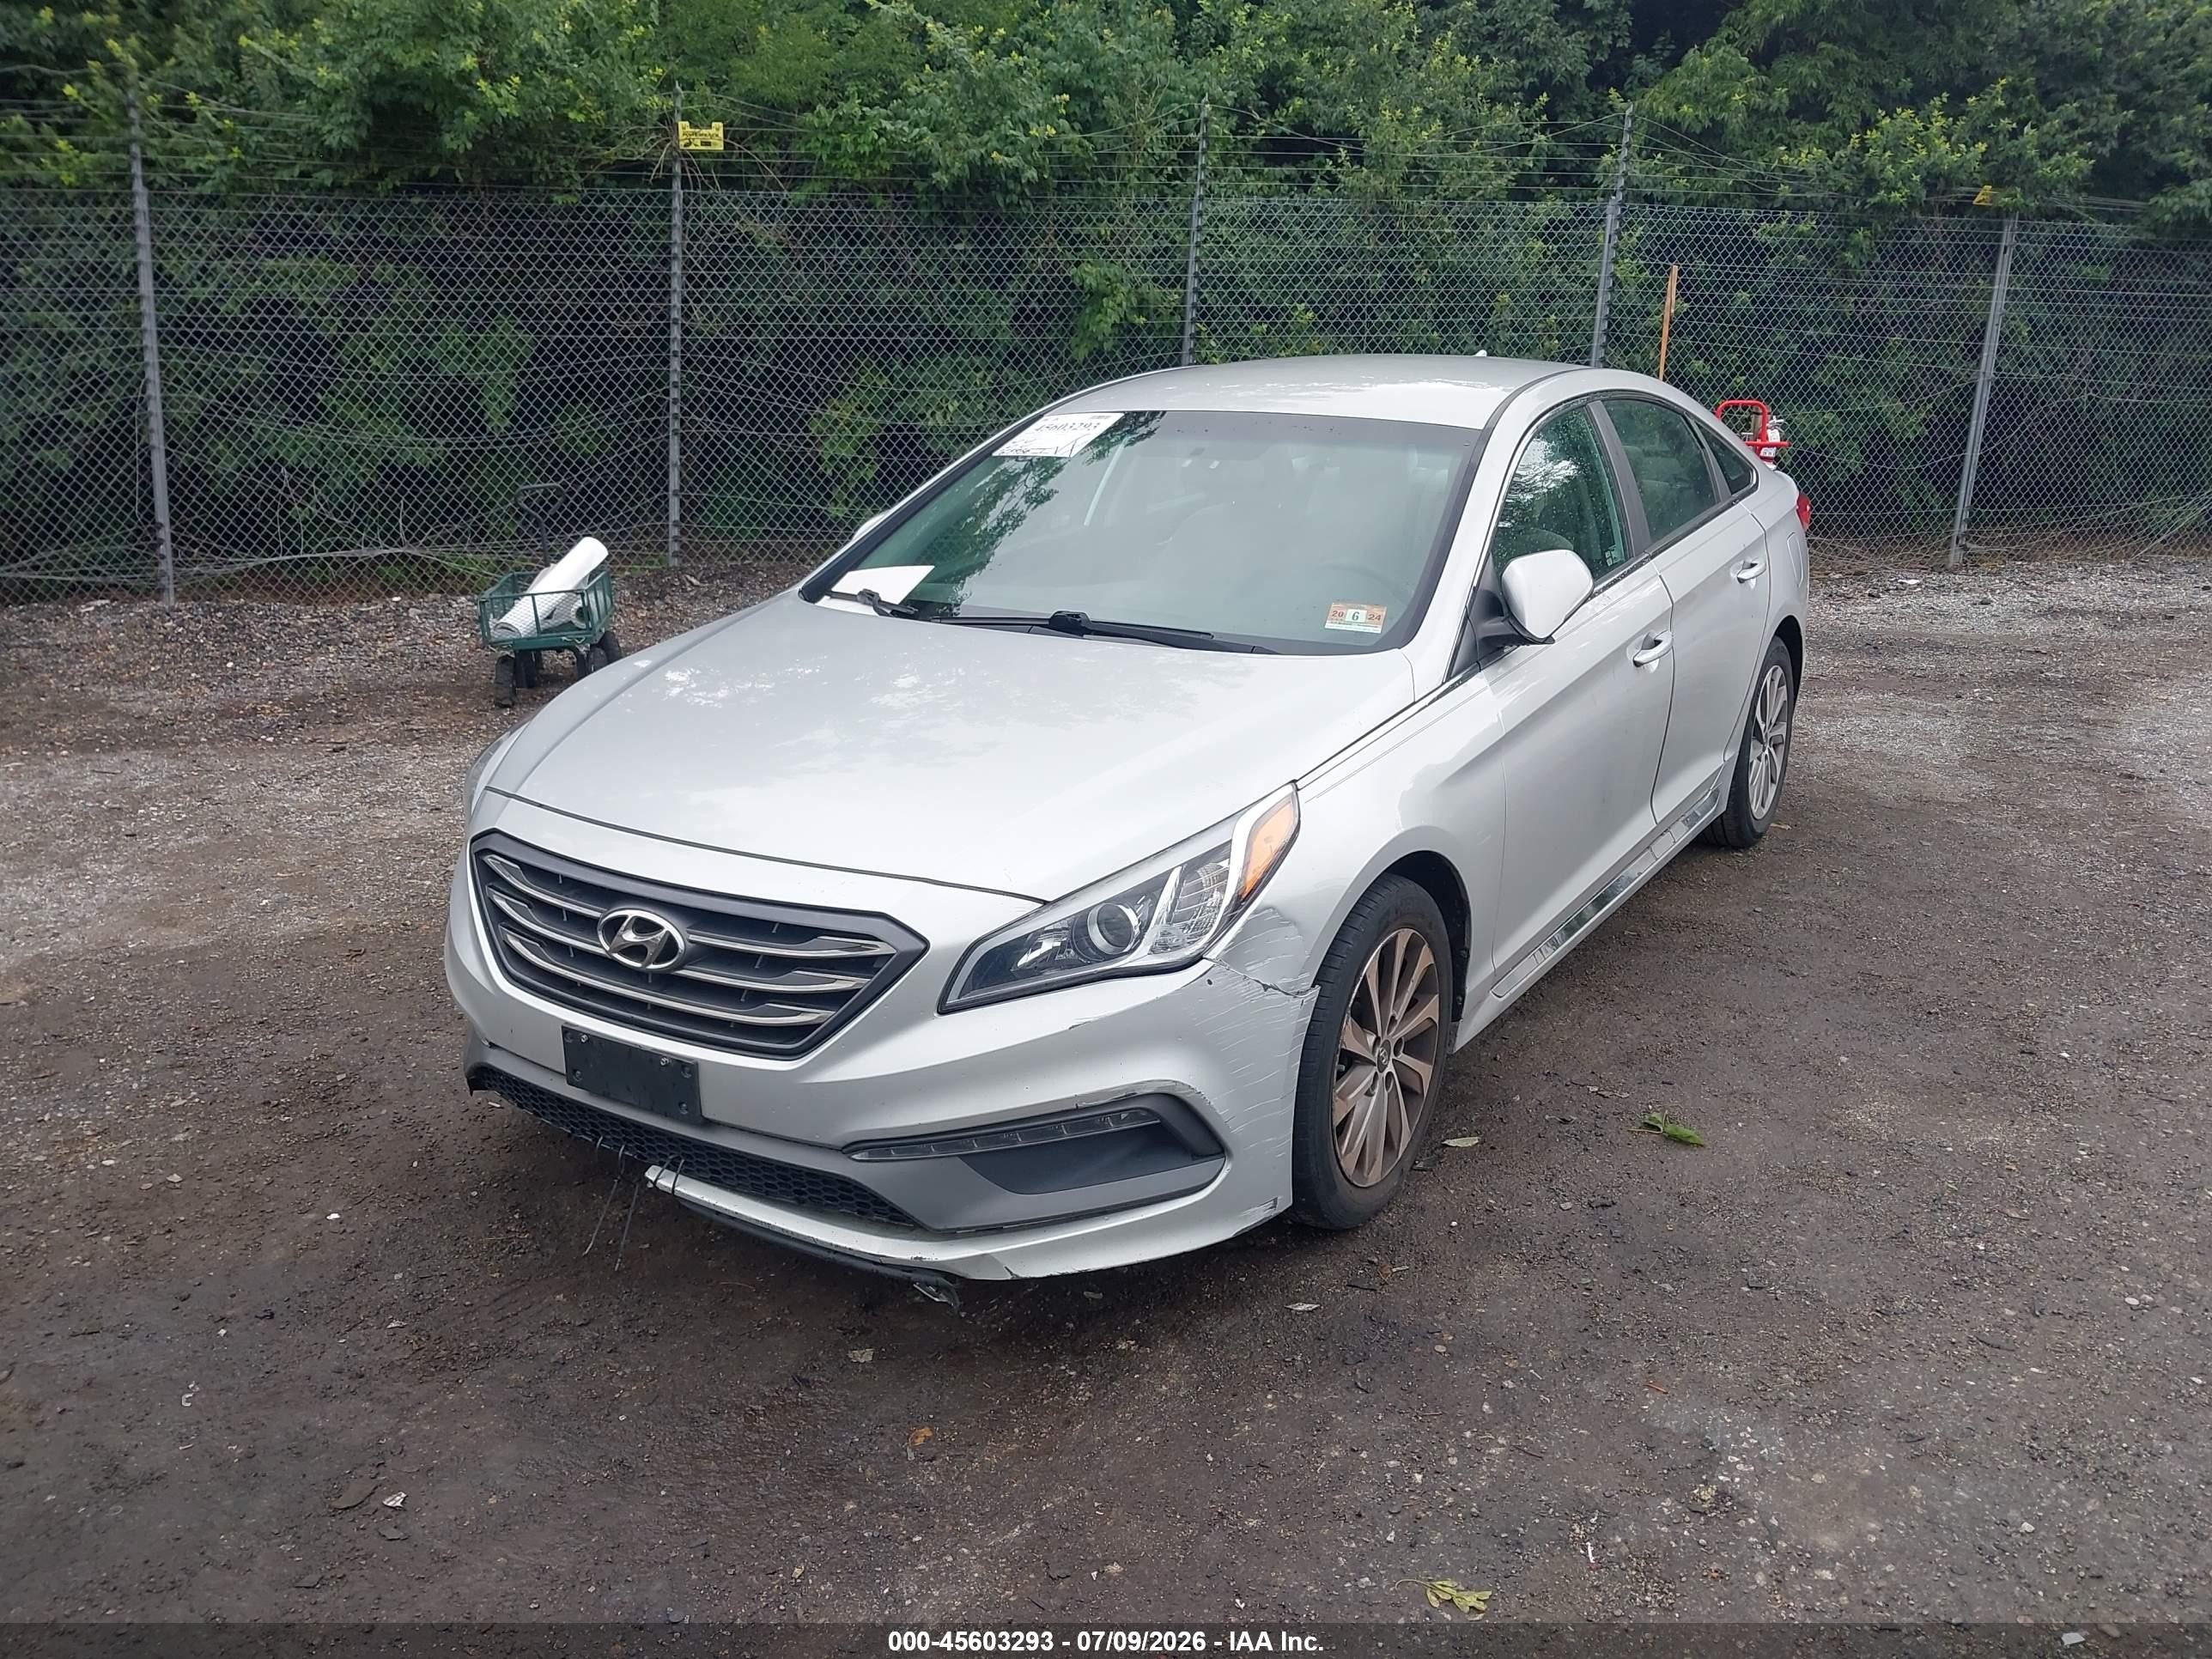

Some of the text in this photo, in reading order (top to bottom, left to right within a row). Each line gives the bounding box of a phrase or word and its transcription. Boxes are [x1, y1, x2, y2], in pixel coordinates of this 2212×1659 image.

[1332, 610, 1382, 622] 20 6 24
